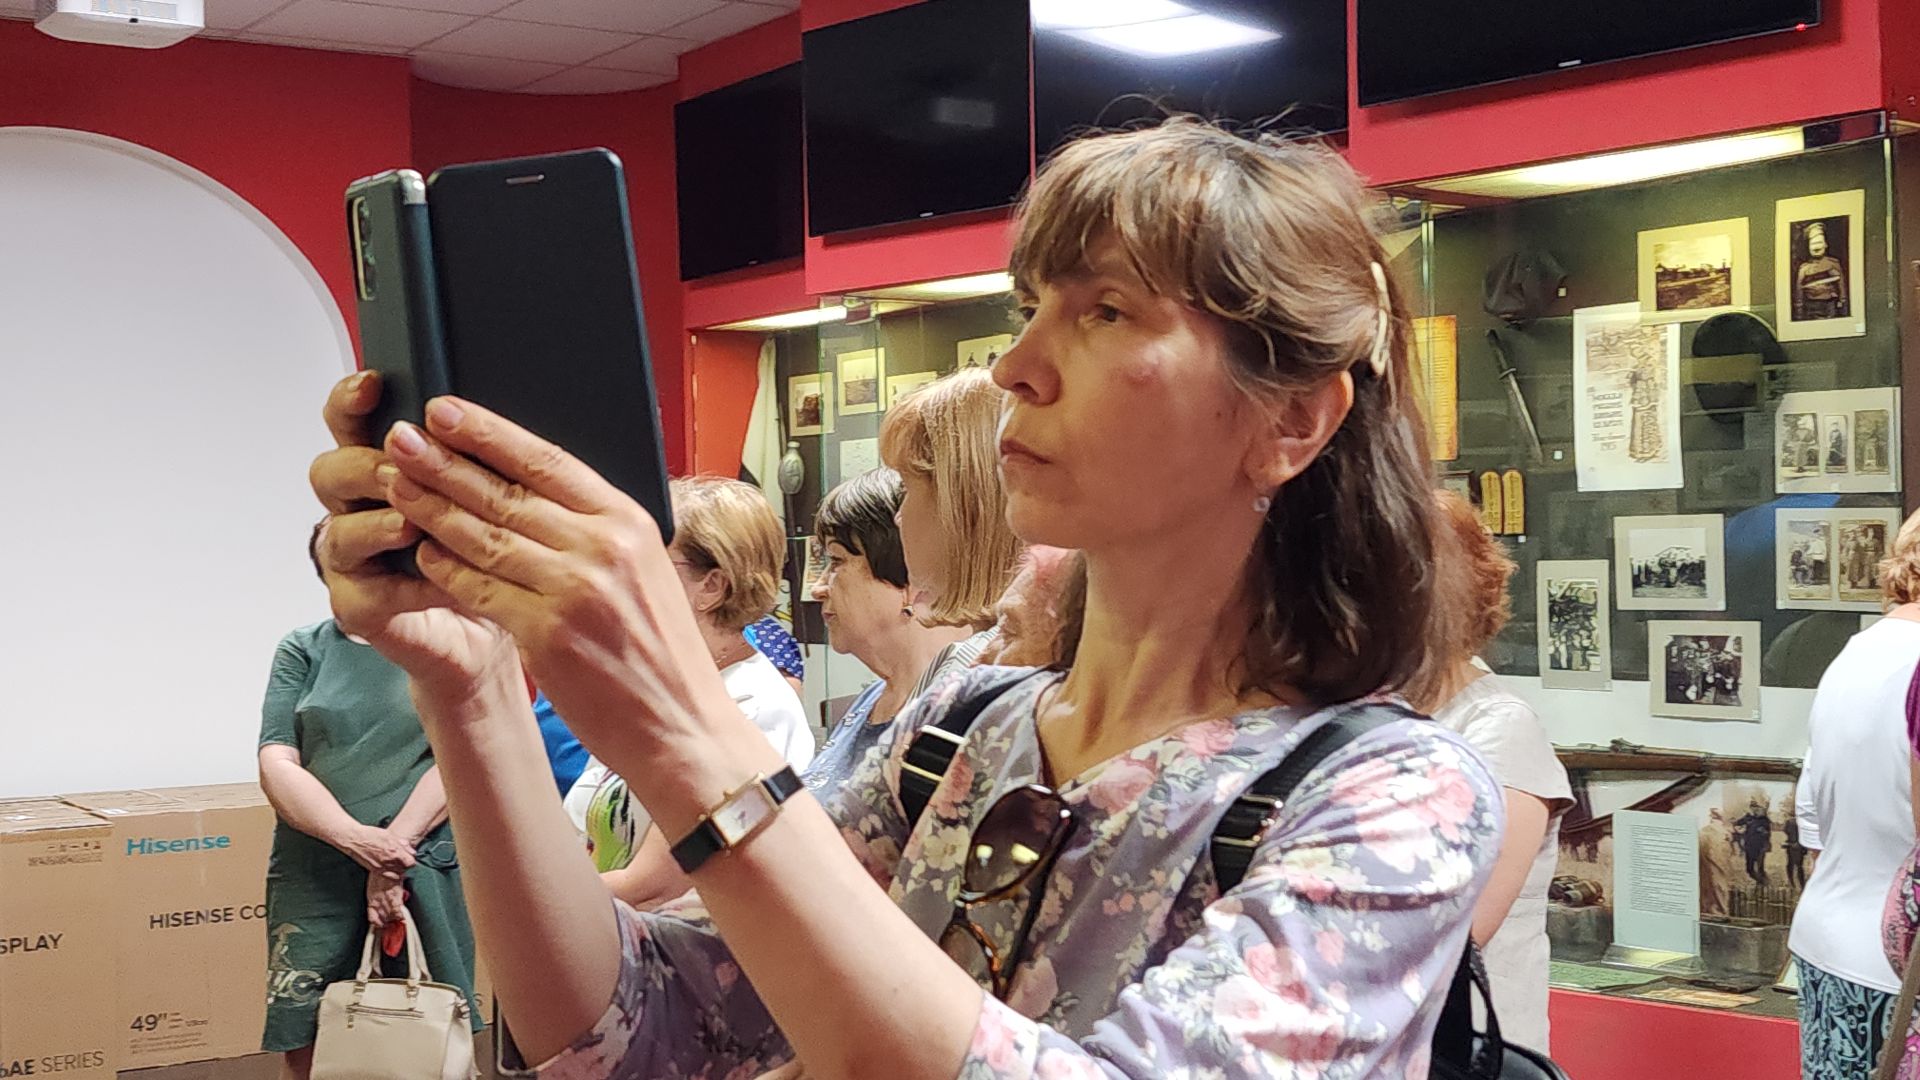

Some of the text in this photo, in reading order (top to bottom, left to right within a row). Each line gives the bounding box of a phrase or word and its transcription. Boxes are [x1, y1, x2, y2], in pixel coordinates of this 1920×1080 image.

[126, 834, 232, 856] Hisense
[149, 907, 234, 930] HISENSE
[41, 1050, 104, 1074] SERIES
